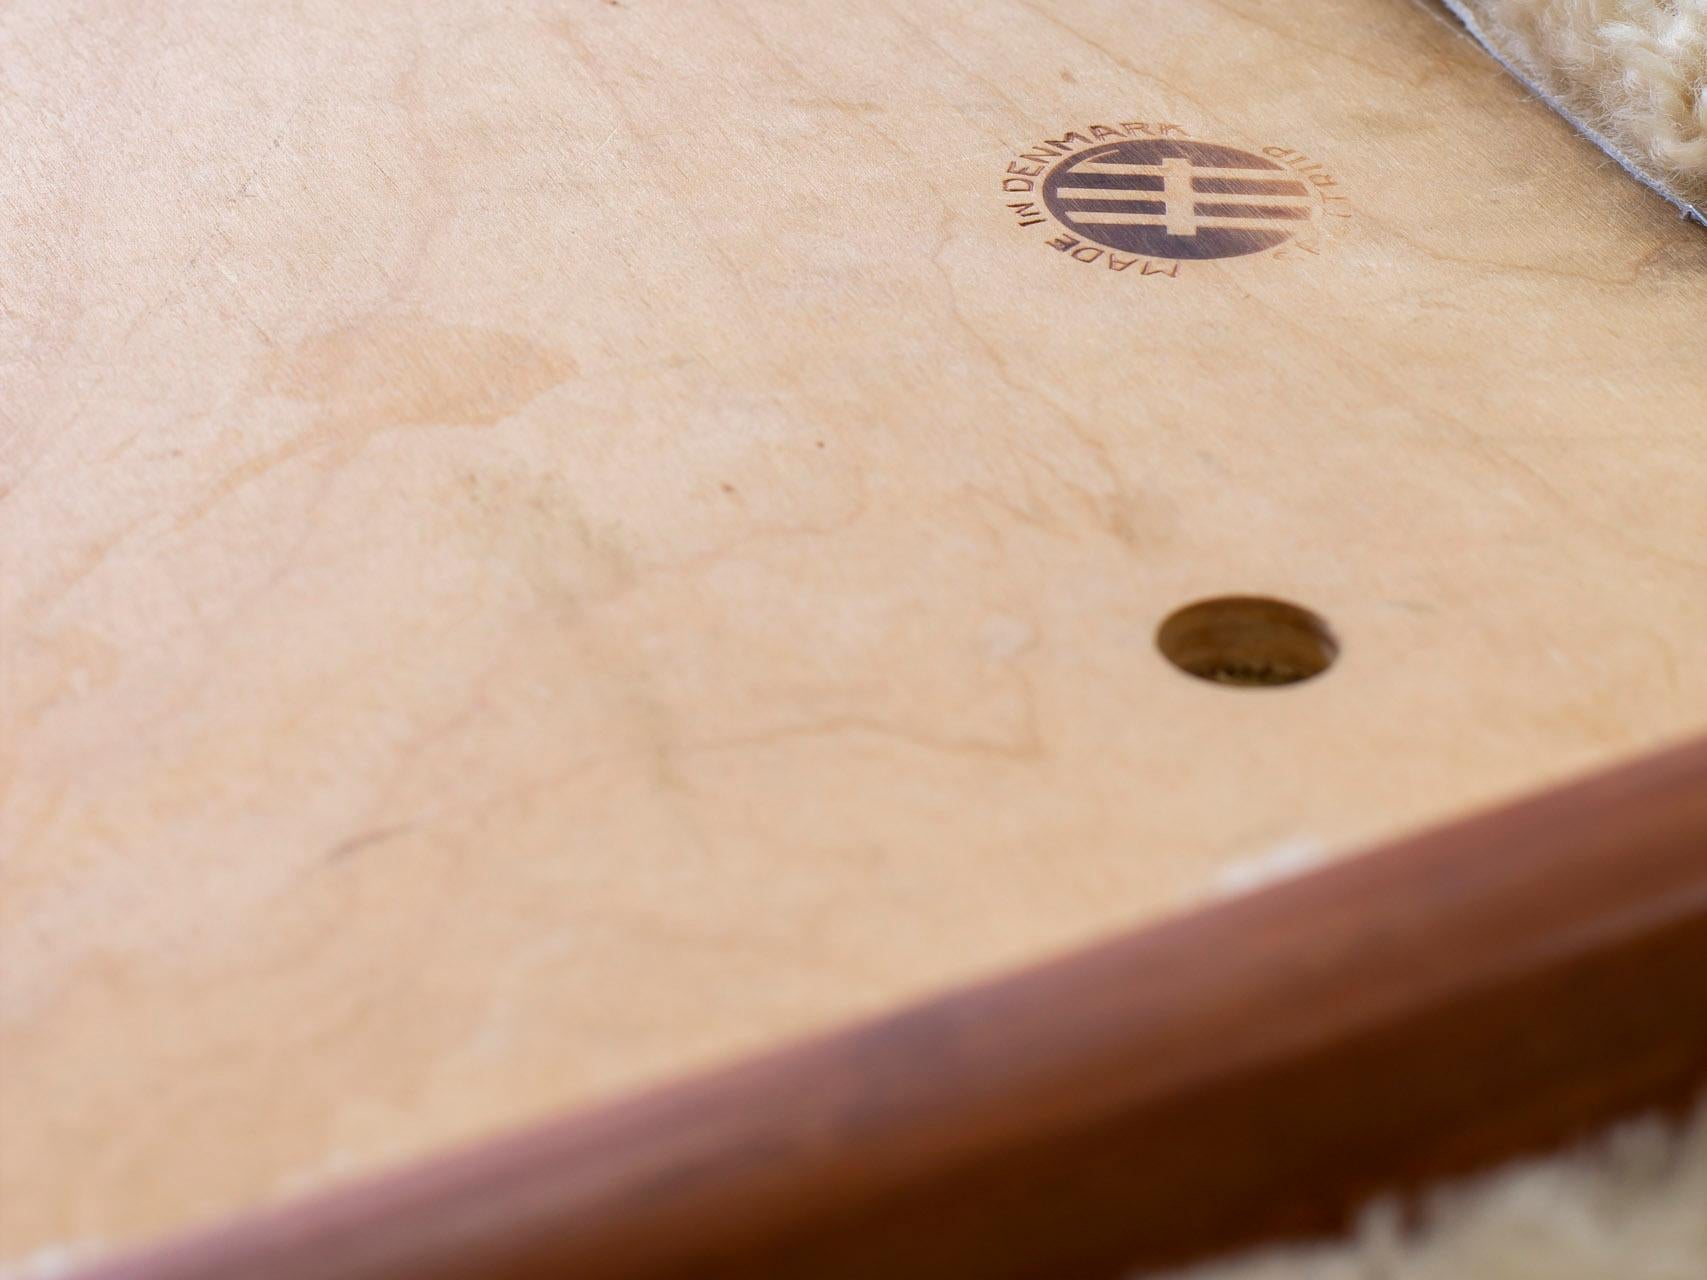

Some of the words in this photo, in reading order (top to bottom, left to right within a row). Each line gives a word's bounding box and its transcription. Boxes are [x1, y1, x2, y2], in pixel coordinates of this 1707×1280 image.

[1003, 122, 1192, 192] DENMARK
[1006, 202, 1047, 227] IN
[1045, 233, 1181, 278] MADE
